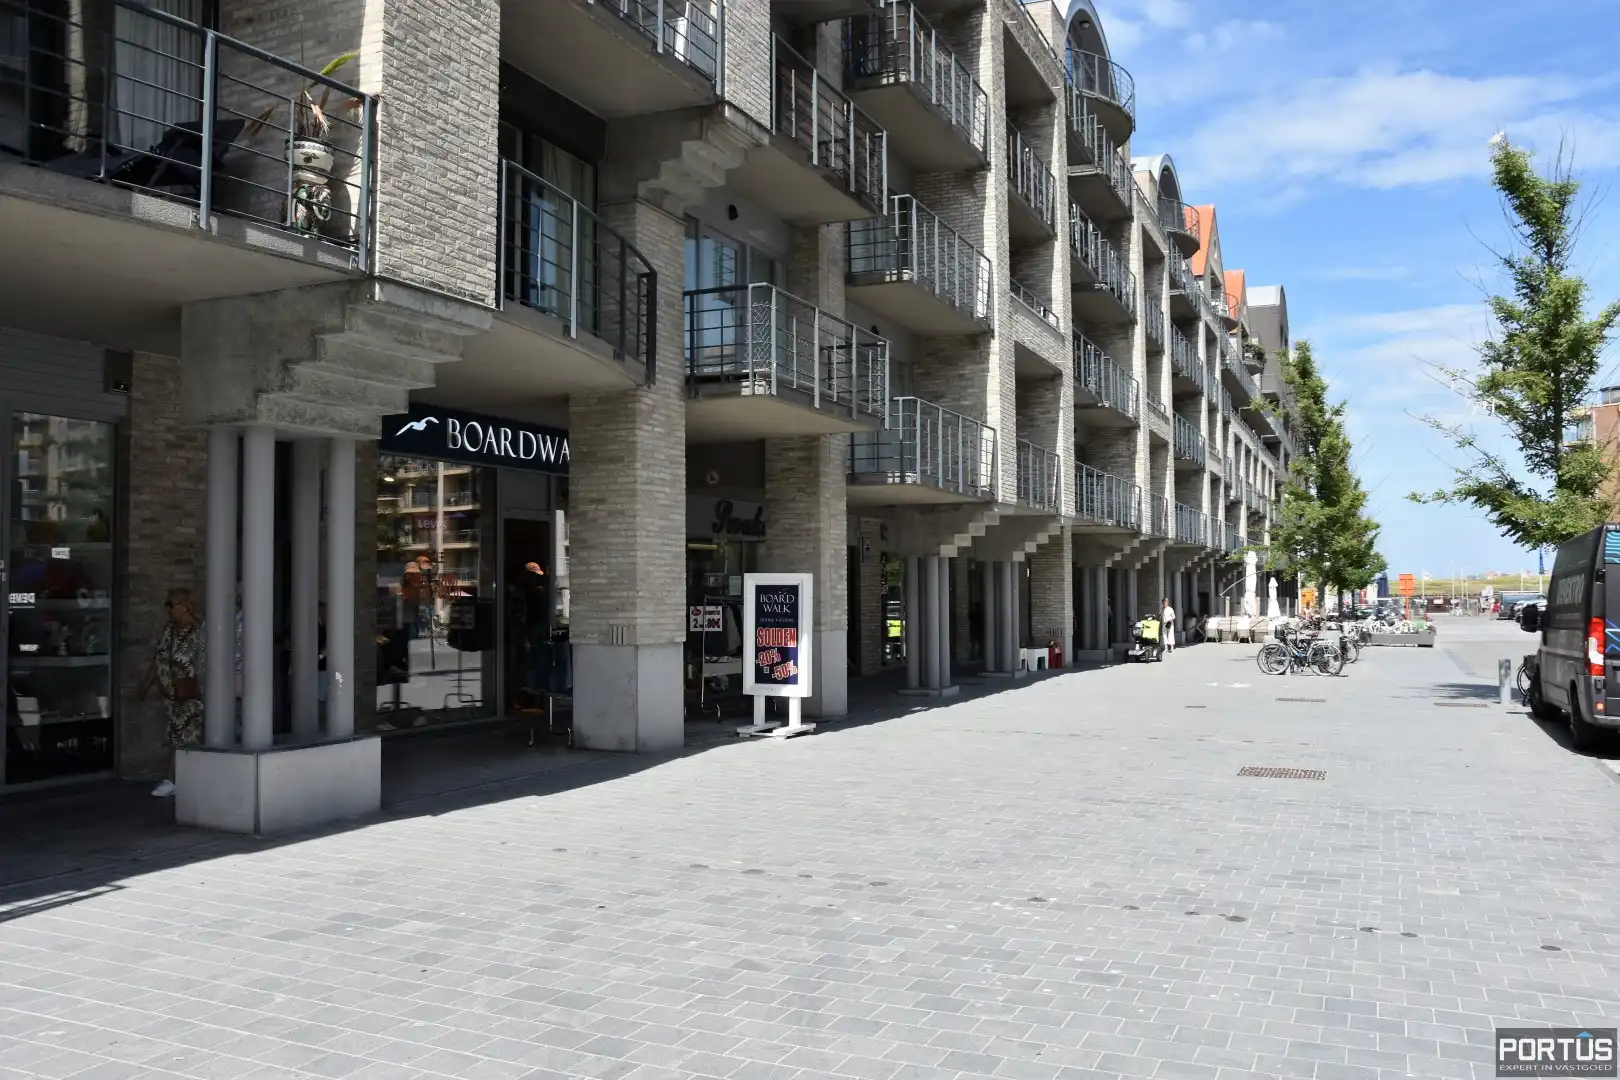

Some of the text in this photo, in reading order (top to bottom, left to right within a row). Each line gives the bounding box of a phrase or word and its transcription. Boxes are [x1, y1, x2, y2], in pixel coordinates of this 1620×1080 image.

[447, 417, 570, 464] BOARDWA
[760, 593, 795, 603] BOARD
[763, 604, 792, 613] WALK
[756, 626, 797, 648] SOLDEN
[756, 648, 782, 667] -20%
[771, 660, 798, 680] -50%
